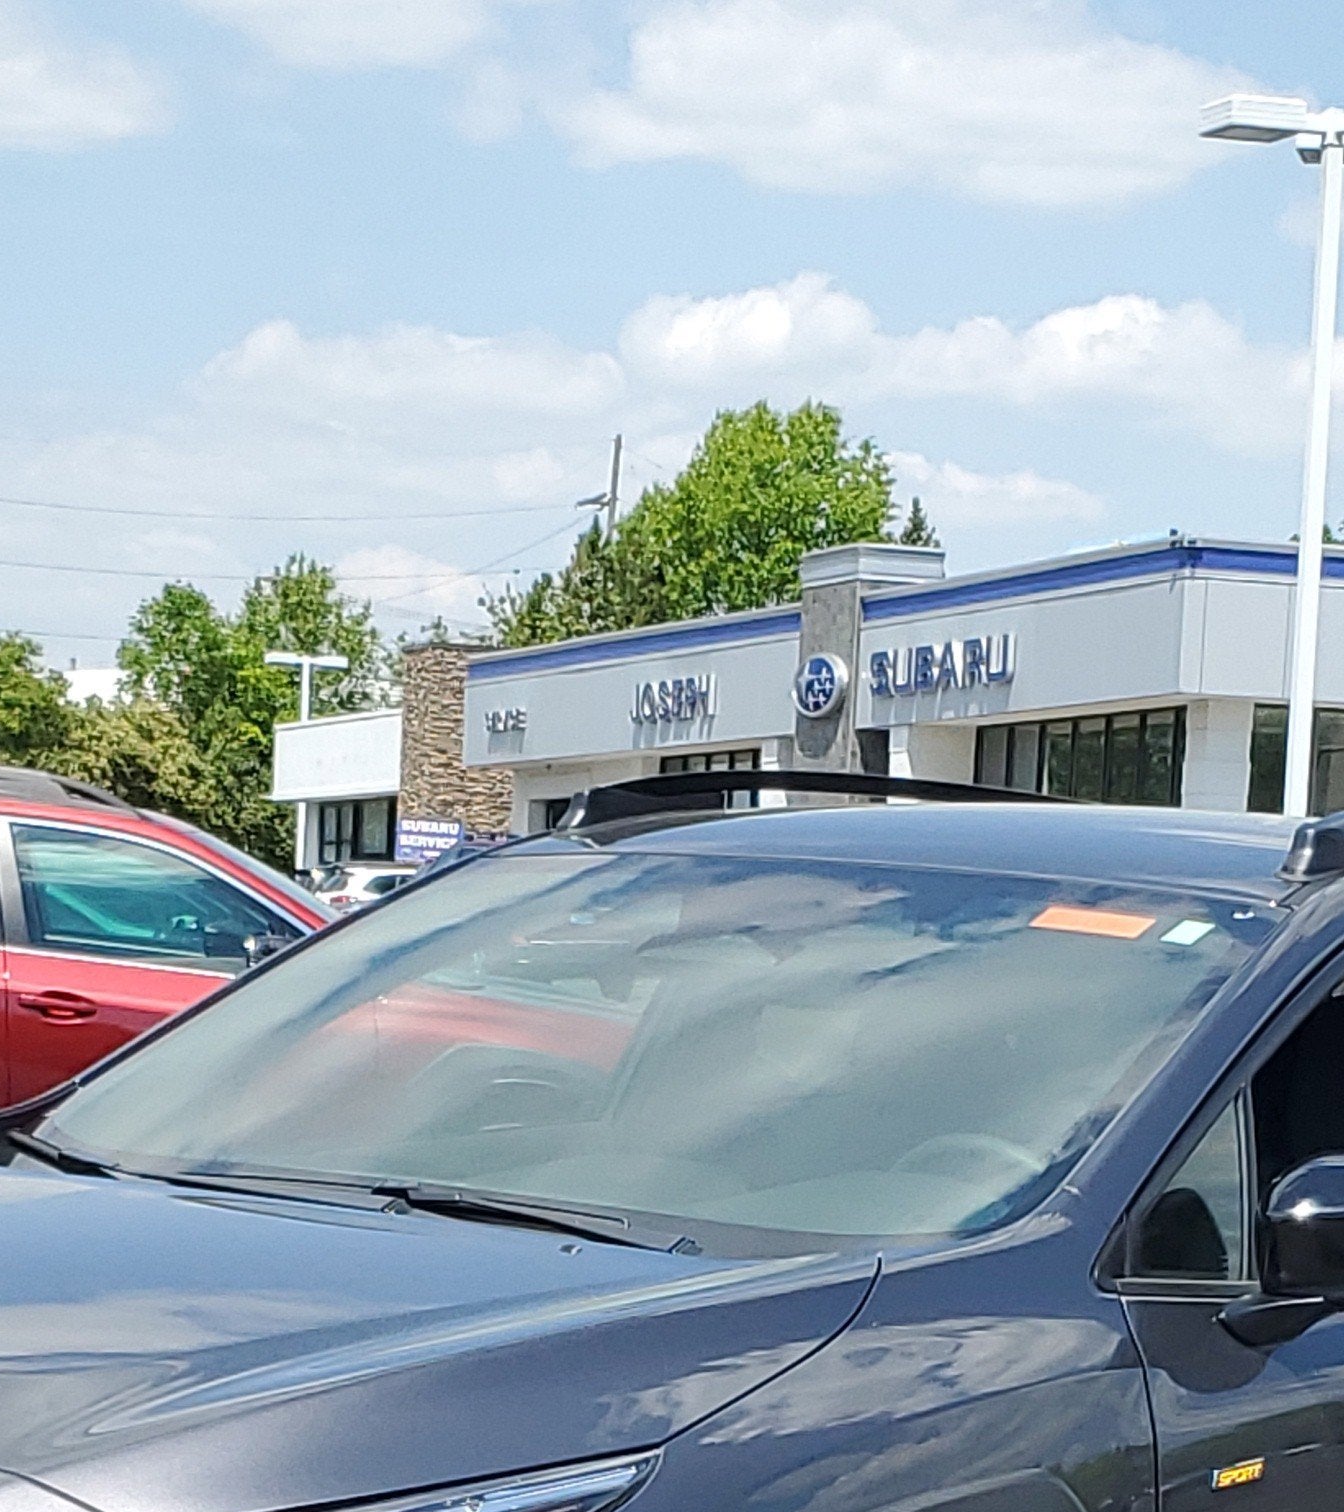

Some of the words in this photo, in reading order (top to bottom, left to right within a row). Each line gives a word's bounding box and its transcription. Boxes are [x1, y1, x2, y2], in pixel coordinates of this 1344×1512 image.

[869, 634, 1017, 697] SUBARU
[628, 673, 718, 725] JOSEPH
[401, 819, 460, 835] SUBARU
[1216, 1460, 1264, 1488] SPORT
